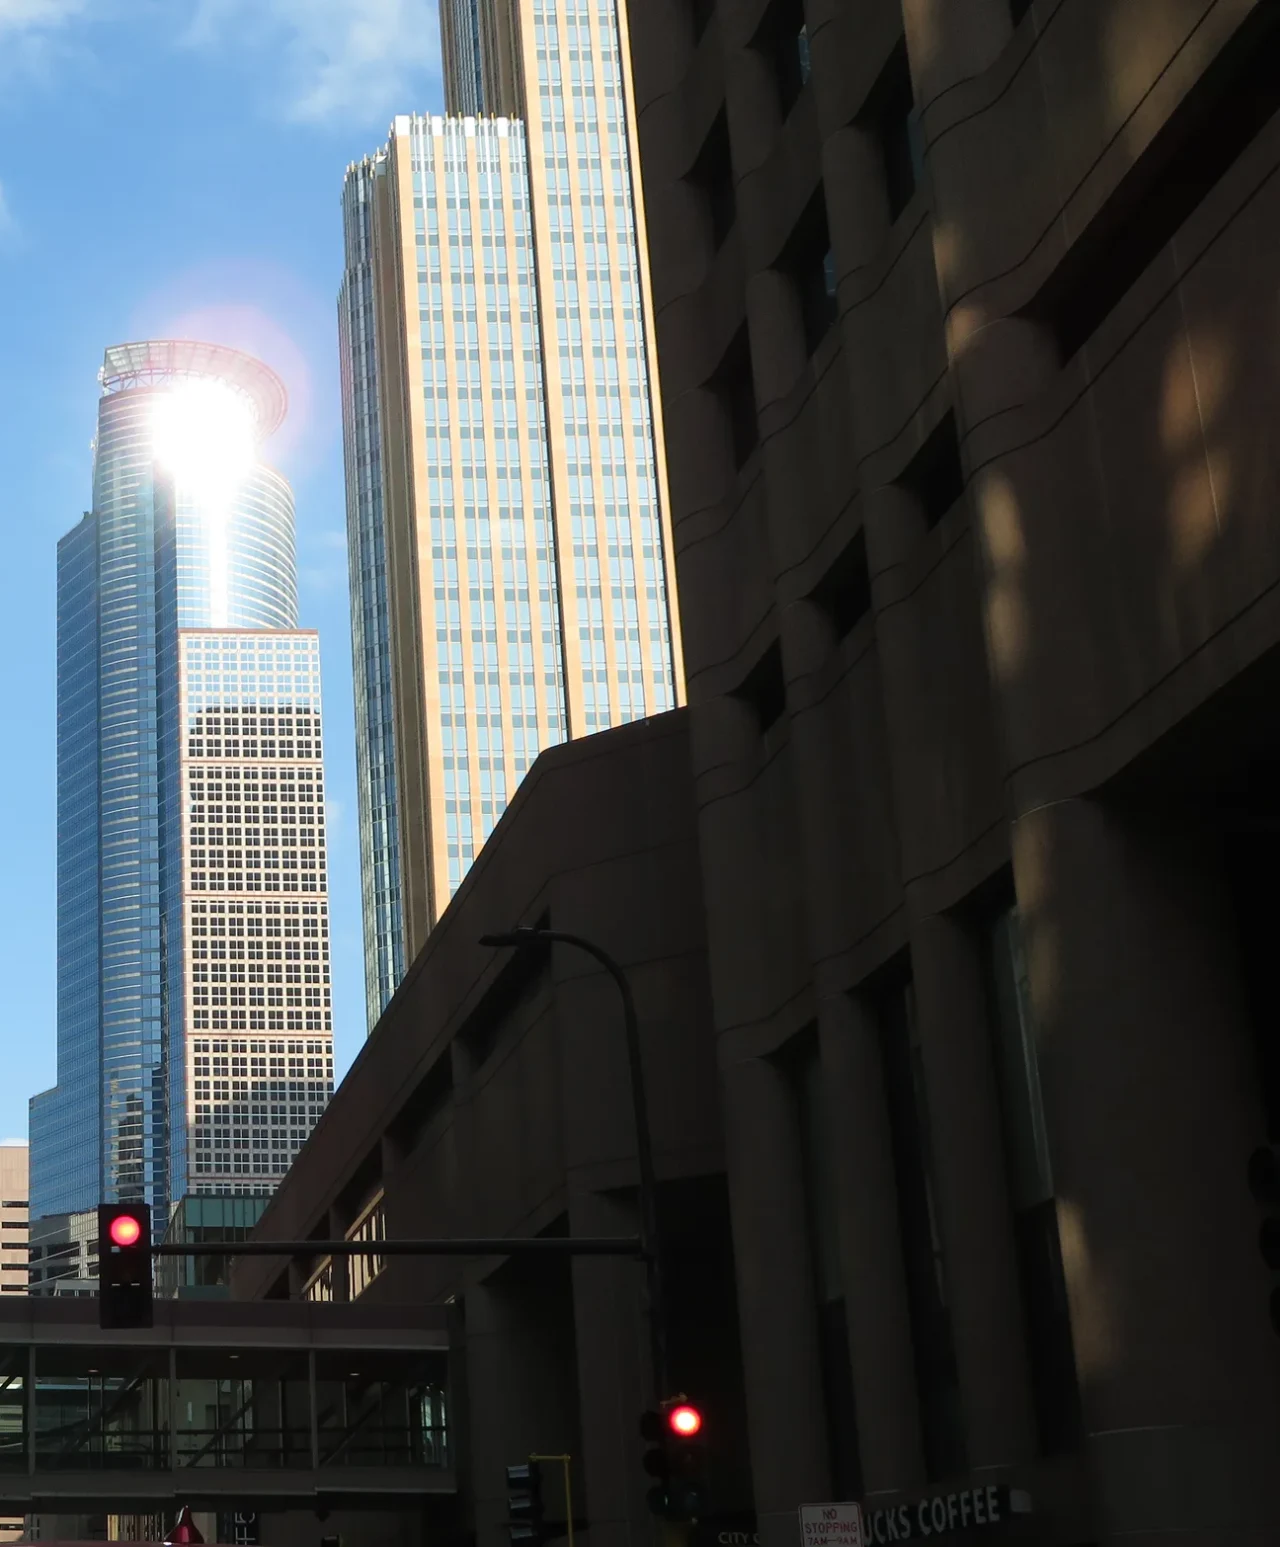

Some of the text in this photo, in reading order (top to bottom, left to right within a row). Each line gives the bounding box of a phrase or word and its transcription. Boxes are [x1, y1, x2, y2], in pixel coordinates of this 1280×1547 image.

[822, 1508, 837, 1520] NO
[918, 1486, 1000, 1536] COFFEE
[805, 1522, 858, 1534] STOPPING
[718, 1532, 749, 1545] CITY
